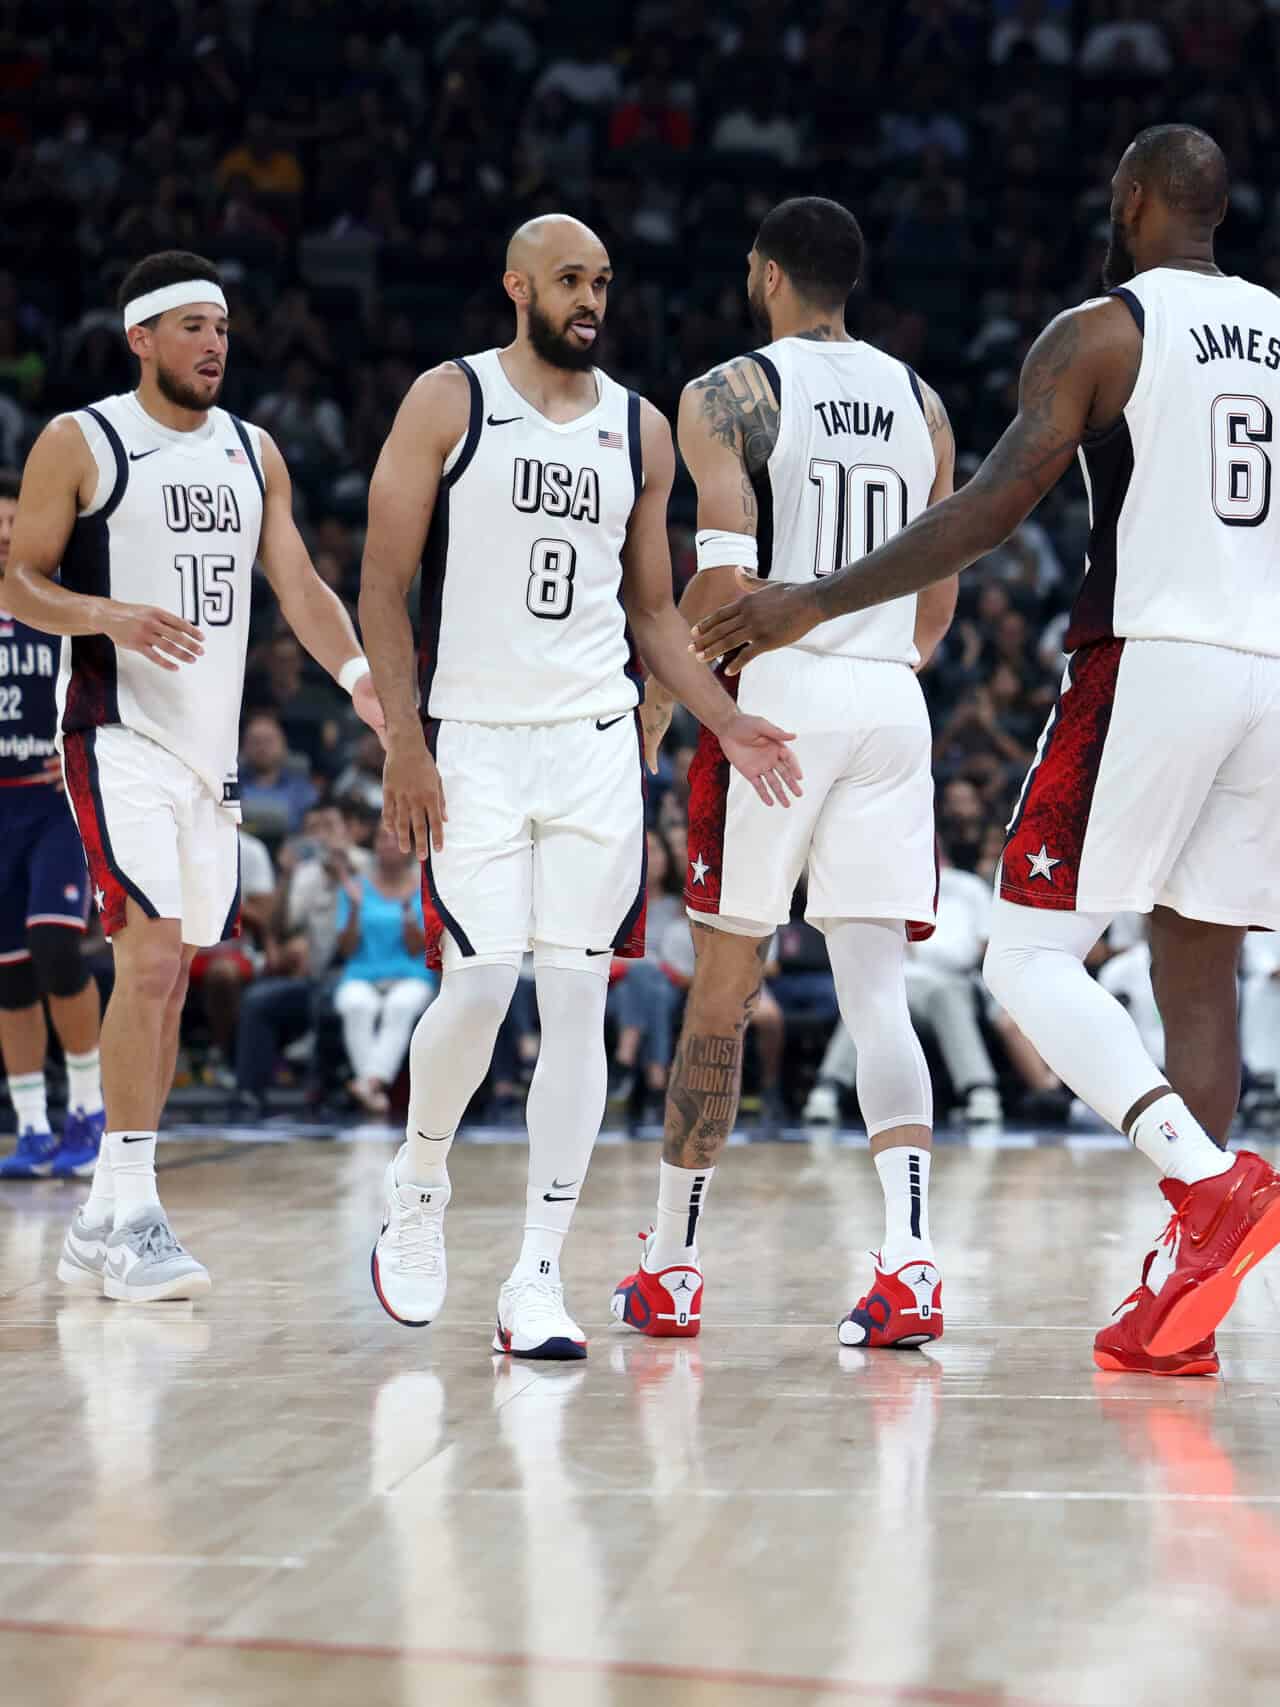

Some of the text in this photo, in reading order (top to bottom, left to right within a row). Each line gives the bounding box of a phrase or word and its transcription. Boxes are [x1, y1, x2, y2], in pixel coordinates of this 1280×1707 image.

[813, 400, 894, 442] TATUM
[511, 457, 600, 525] USA
[1210, 393, 1273, 527] 6
[162, 484, 241, 533] USA
[808, 458, 908, 577] 10
[173, 553, 235, 627] 15
[526, 537, 577, 620] 8
